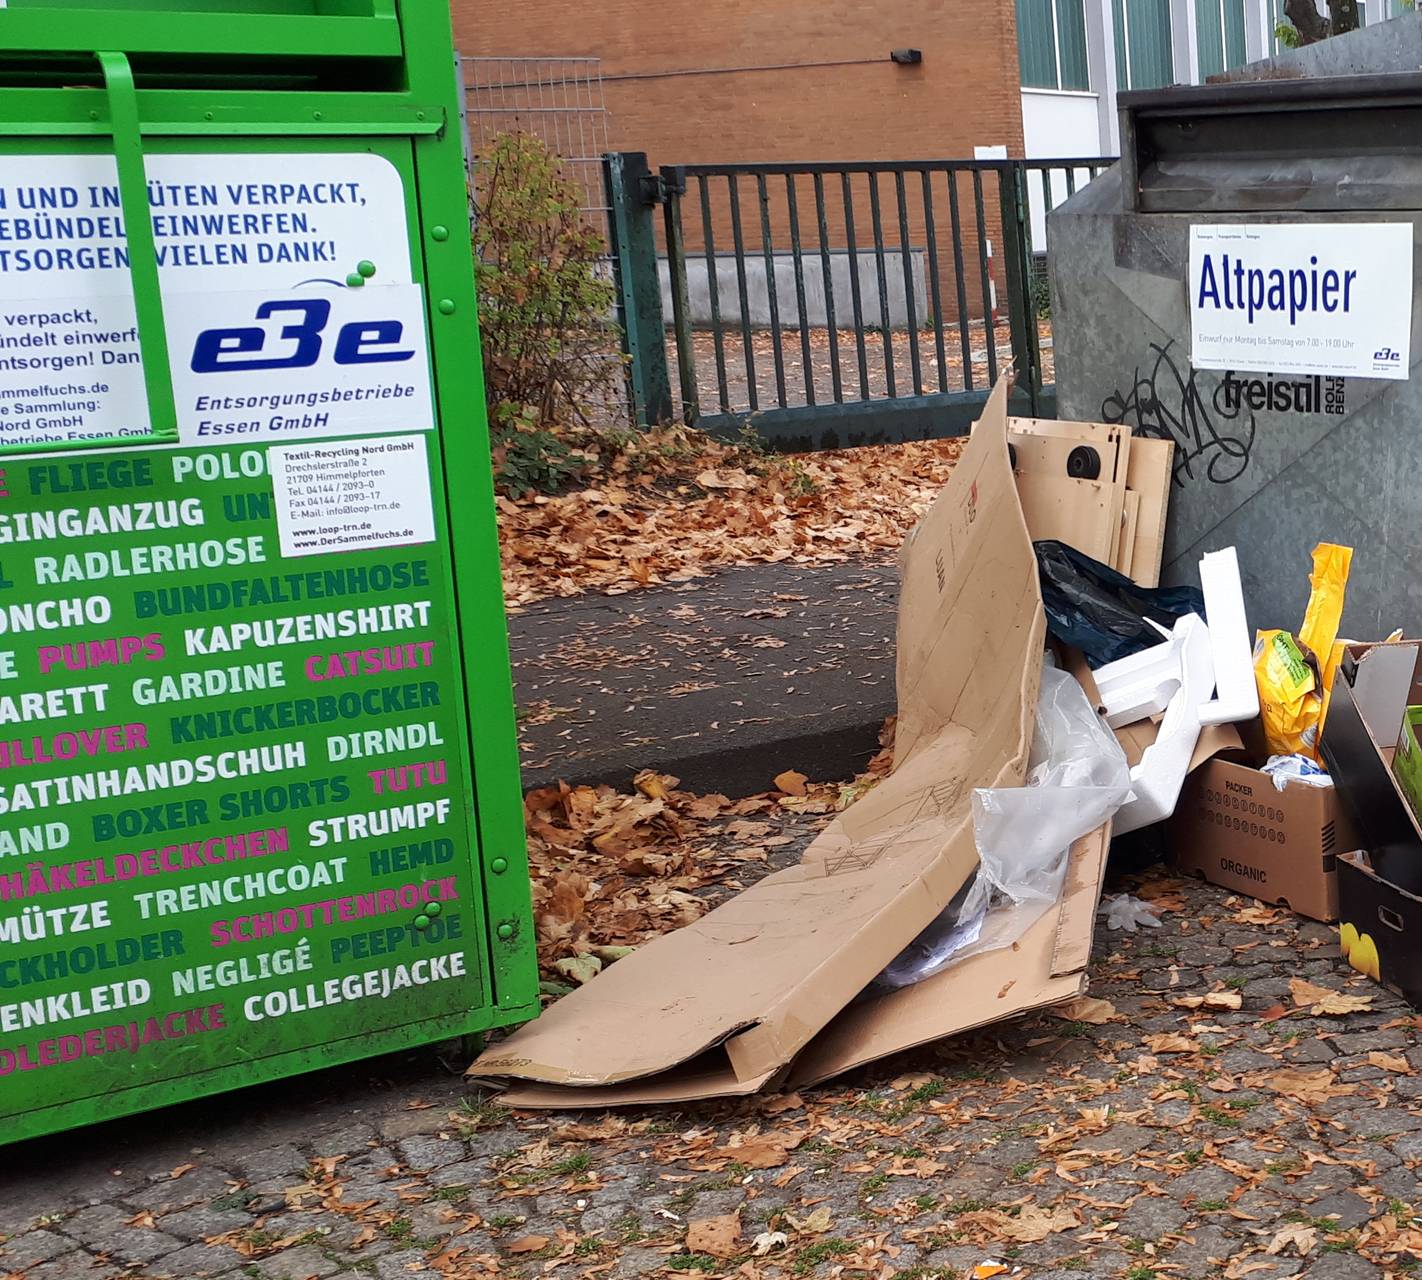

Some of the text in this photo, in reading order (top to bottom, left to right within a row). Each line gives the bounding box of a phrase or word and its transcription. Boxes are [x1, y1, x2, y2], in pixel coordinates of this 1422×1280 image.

[17, 187, 79, 209] UND
[88, 186, 120, 208] IN
[147, 180, 218, 207] ÜTEN
[225, 182, 367, 207] VERPACKT,
[0, 212, 317, 241] EBÜNDEL EINWERFEN.
[155, 243, 248, 267] VIELEN
[256, 241, 336, 264] DANK!
[1198, 254, 1357, 325] Altpapier
[4, 309, 98, 328] verpackt,
[64, 328, 140, 345] einwerf
[190, 298, 416, 374] e3e
[1199, 334, 1222, 343] Einwurf
[1235, 336, 1256, 346] Montag
[1268, 337, 1293, 347] Samstag
[102, 351, 140, 365] Dan
[0, 382, 109, 399] mmelfuchs.de
[194, 384, 415, 412] Entsorgungsbetriebe
[1221, 370, 1320, 413] freistil
[14, 400, 101, 415] Sammlung:
[35, 415, 83, 429] GmbH
[118, 426, 154, 436] Gmb
[197, 413, 329, 436] Essen GmbH
[283, 442, 414, 461] Textil-Recycling Nord GmbH
[285, 458, 367, 472] Drechslerstraße 2
[28, 457, 154, 495] FLIEGE
[171, 450, 274, 483] POLO
[285, 468, 385, 484] 21709 Himmelpforten
[287, 487, 302, 496] Tel.
[306, 484, 333, 494] 04144
[288, 499, 305, 508] Fax
[307, 495, 335, 506] 04144
[222, 492, 275, 522] UN
[289, 501, 401, 519] E-Mail: info@loop-trn.de
[291, 522, 372, 537] www.loop-trn.de
[292, 528, 414, 548] www.DerSammelfuchs.de
[34, 535, 267, 585] RADLERHOSE
[133, 560, 430, 619] BUNDFALTENHOSE
[38, 632, 166, 674] PUMPS
[184, 600, 432, 657] KAPUZENSHIRT
[0, 640, 435, 725] ARETT GARDINE CATSUIT
[170, 681, 441, 744] KNICKERBOCKER
[327, 721, 444, 762] DIRNDL
[92, 799, 210, 843] BOXER
[219, 776, 350, 821] SHORTS
[367, 759, 447, 795] TUTU
[1225, 780, 1253, 797] PACKER
[0, 798, 450, 902] HÄKELDECKCHEN STRUMPF
[1220, 857, 1267, 883] ORGANIC
[0, 838, 454, 944] MÜTZE TRENCHCOAT HEMD
[0, 876, 459, 989] CKHOLDER SCHOTTENROCK
[0, 914, 463, 1033] ENKLEID NEGLIGÉ PEEPTOE
[243, 952, 466, 1022] COLLEGEJACKE
